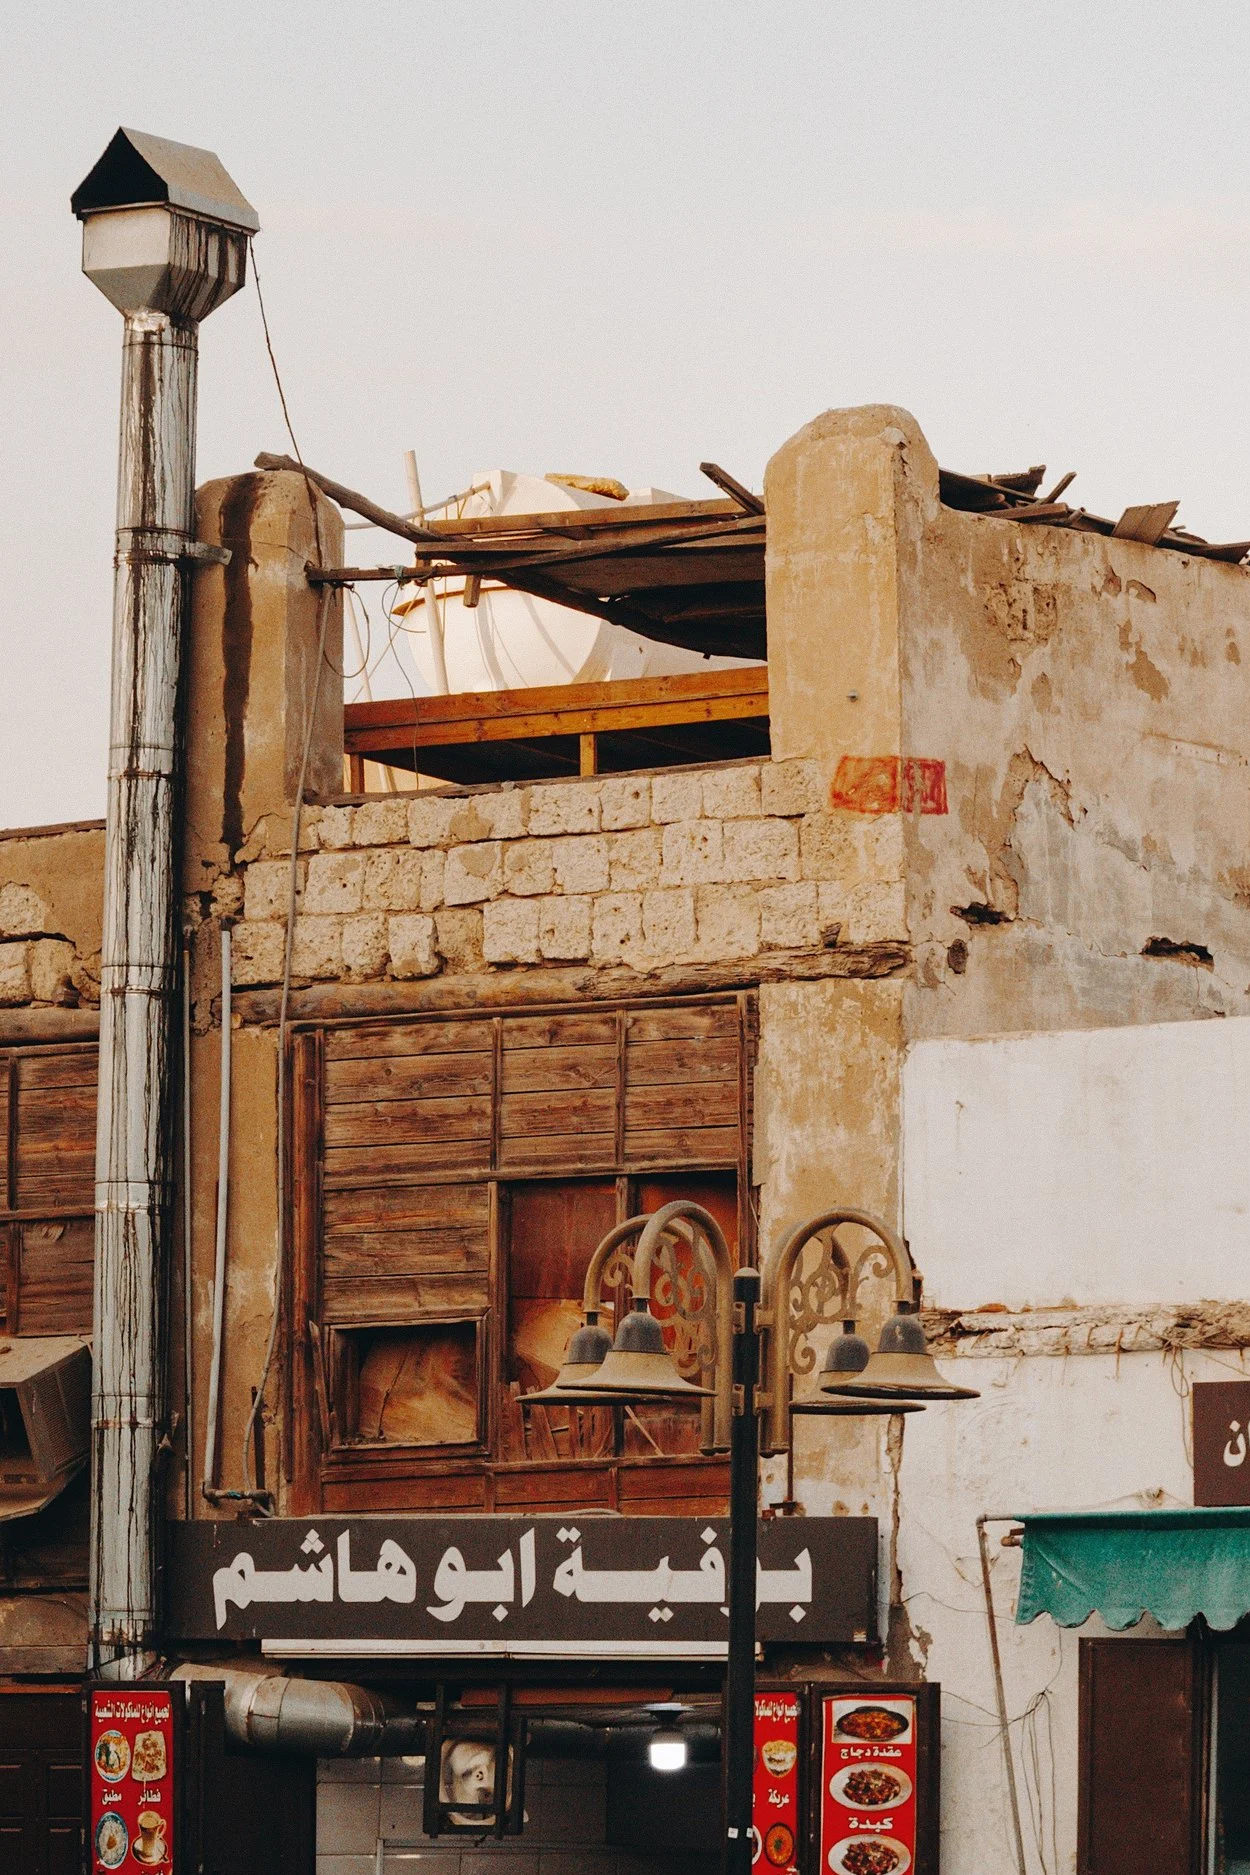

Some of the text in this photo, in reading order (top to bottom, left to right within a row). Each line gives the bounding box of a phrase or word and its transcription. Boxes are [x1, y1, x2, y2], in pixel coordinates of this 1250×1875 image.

[213, 1526, 812, 1630] بفية ابو هاشم
[840, 1746, 871, 1759] دجاج
[848, 1817, 893, 1833] كبدة
